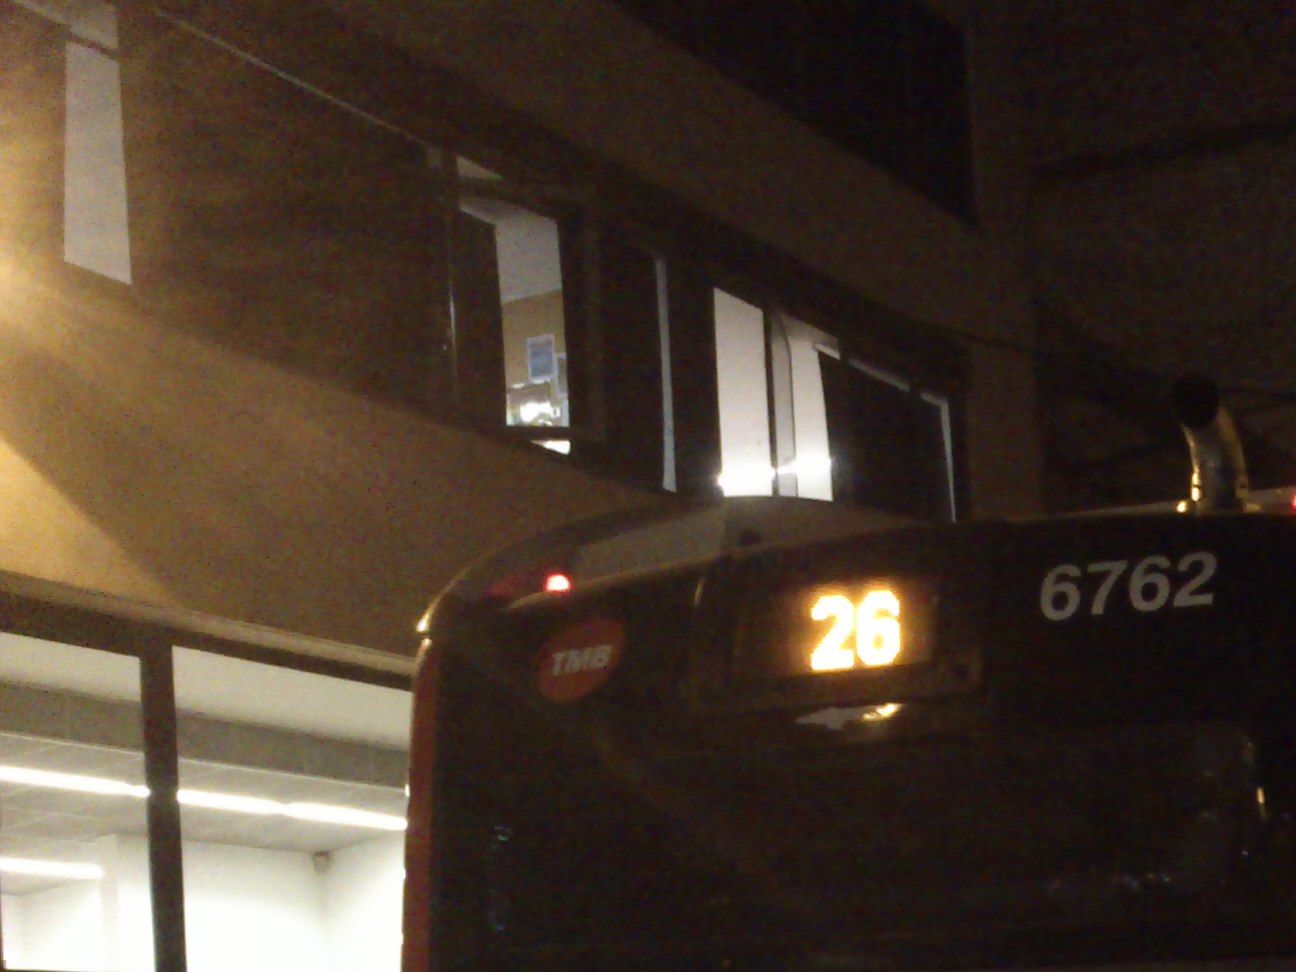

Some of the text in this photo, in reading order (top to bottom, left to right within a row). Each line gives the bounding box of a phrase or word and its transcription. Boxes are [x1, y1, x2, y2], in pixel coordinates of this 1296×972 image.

[1040, 551, 1219, 621] 6762
[550, 643, 612, 677] TMB
[810, 590, 901, 671] 26
